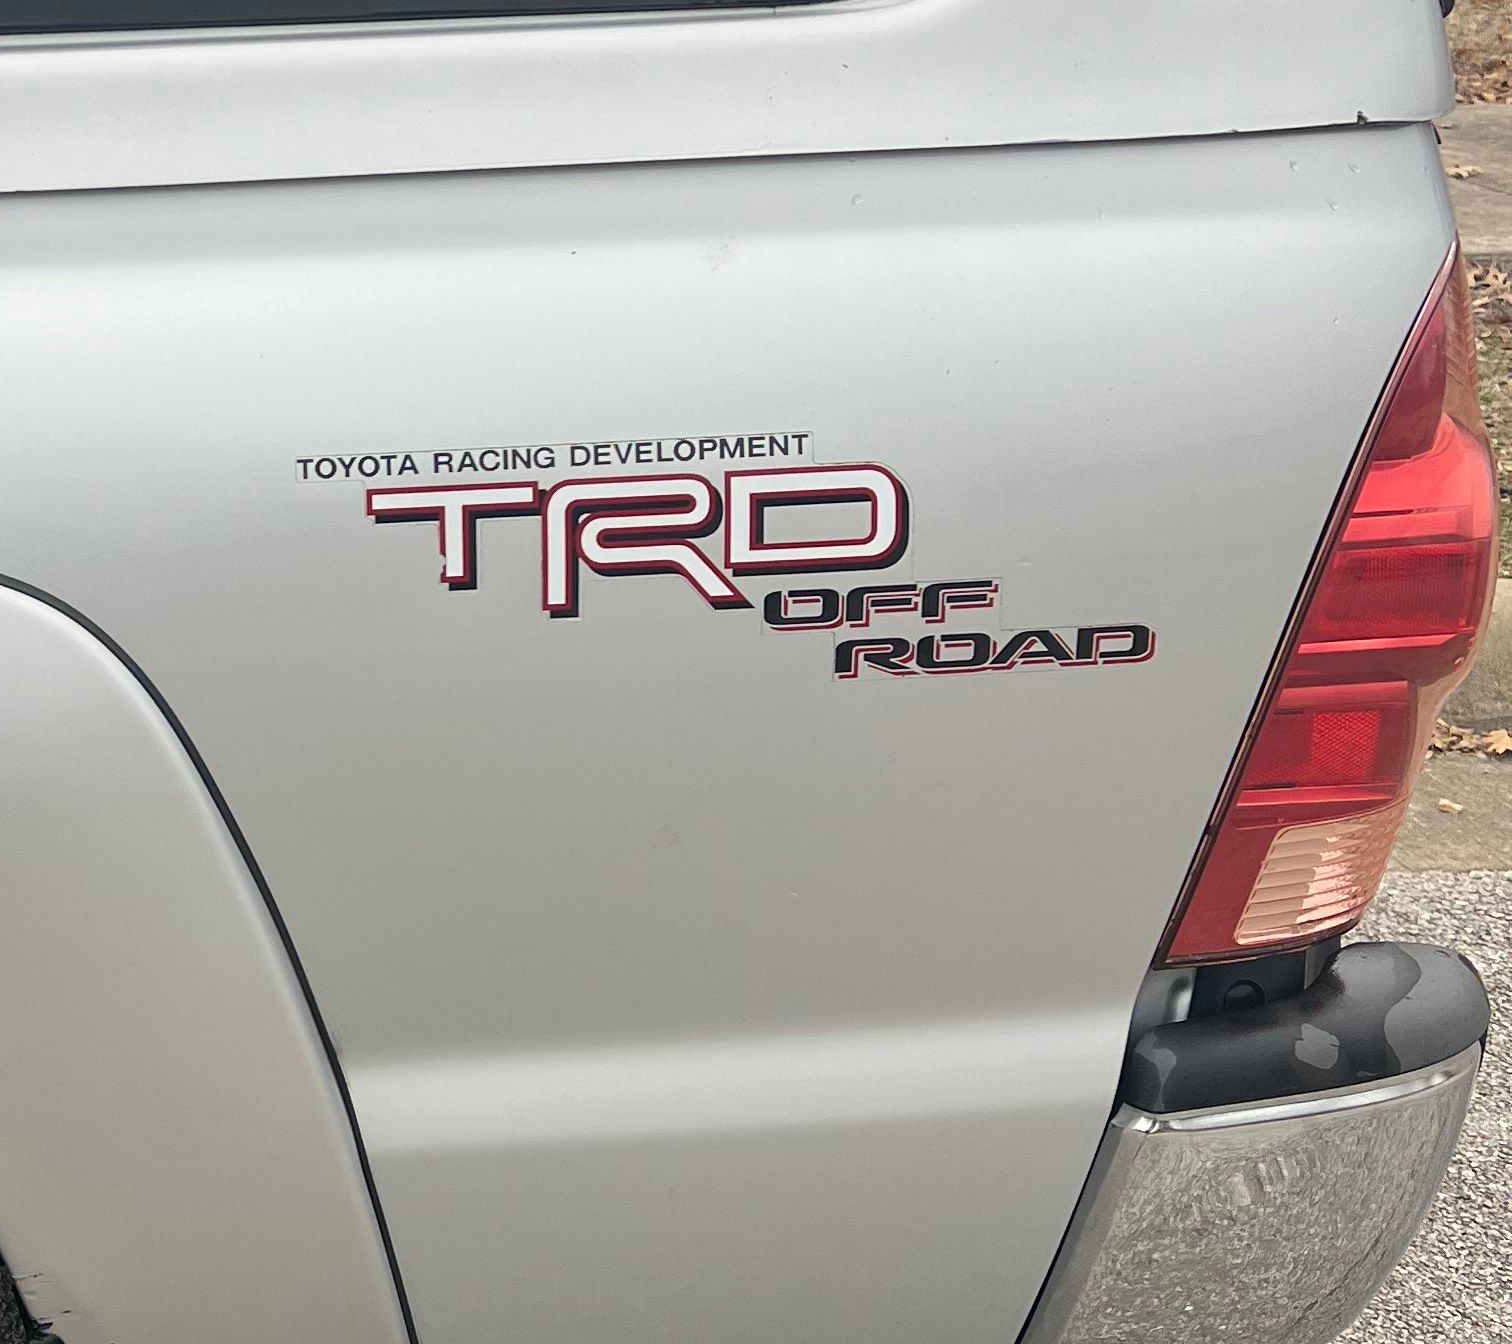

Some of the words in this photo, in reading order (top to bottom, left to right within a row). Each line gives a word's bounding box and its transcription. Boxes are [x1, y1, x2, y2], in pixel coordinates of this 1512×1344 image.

[296, 453, 420, 480] TOYOTA
[433, 446, 556, 474] RACING
[569, 433, 810, 467] DEVELOPMENT
[365, 463, 910, 620] TRD
[763, 579, 999, 631] OFF
[833, 623, 1157, 679] ROAD
